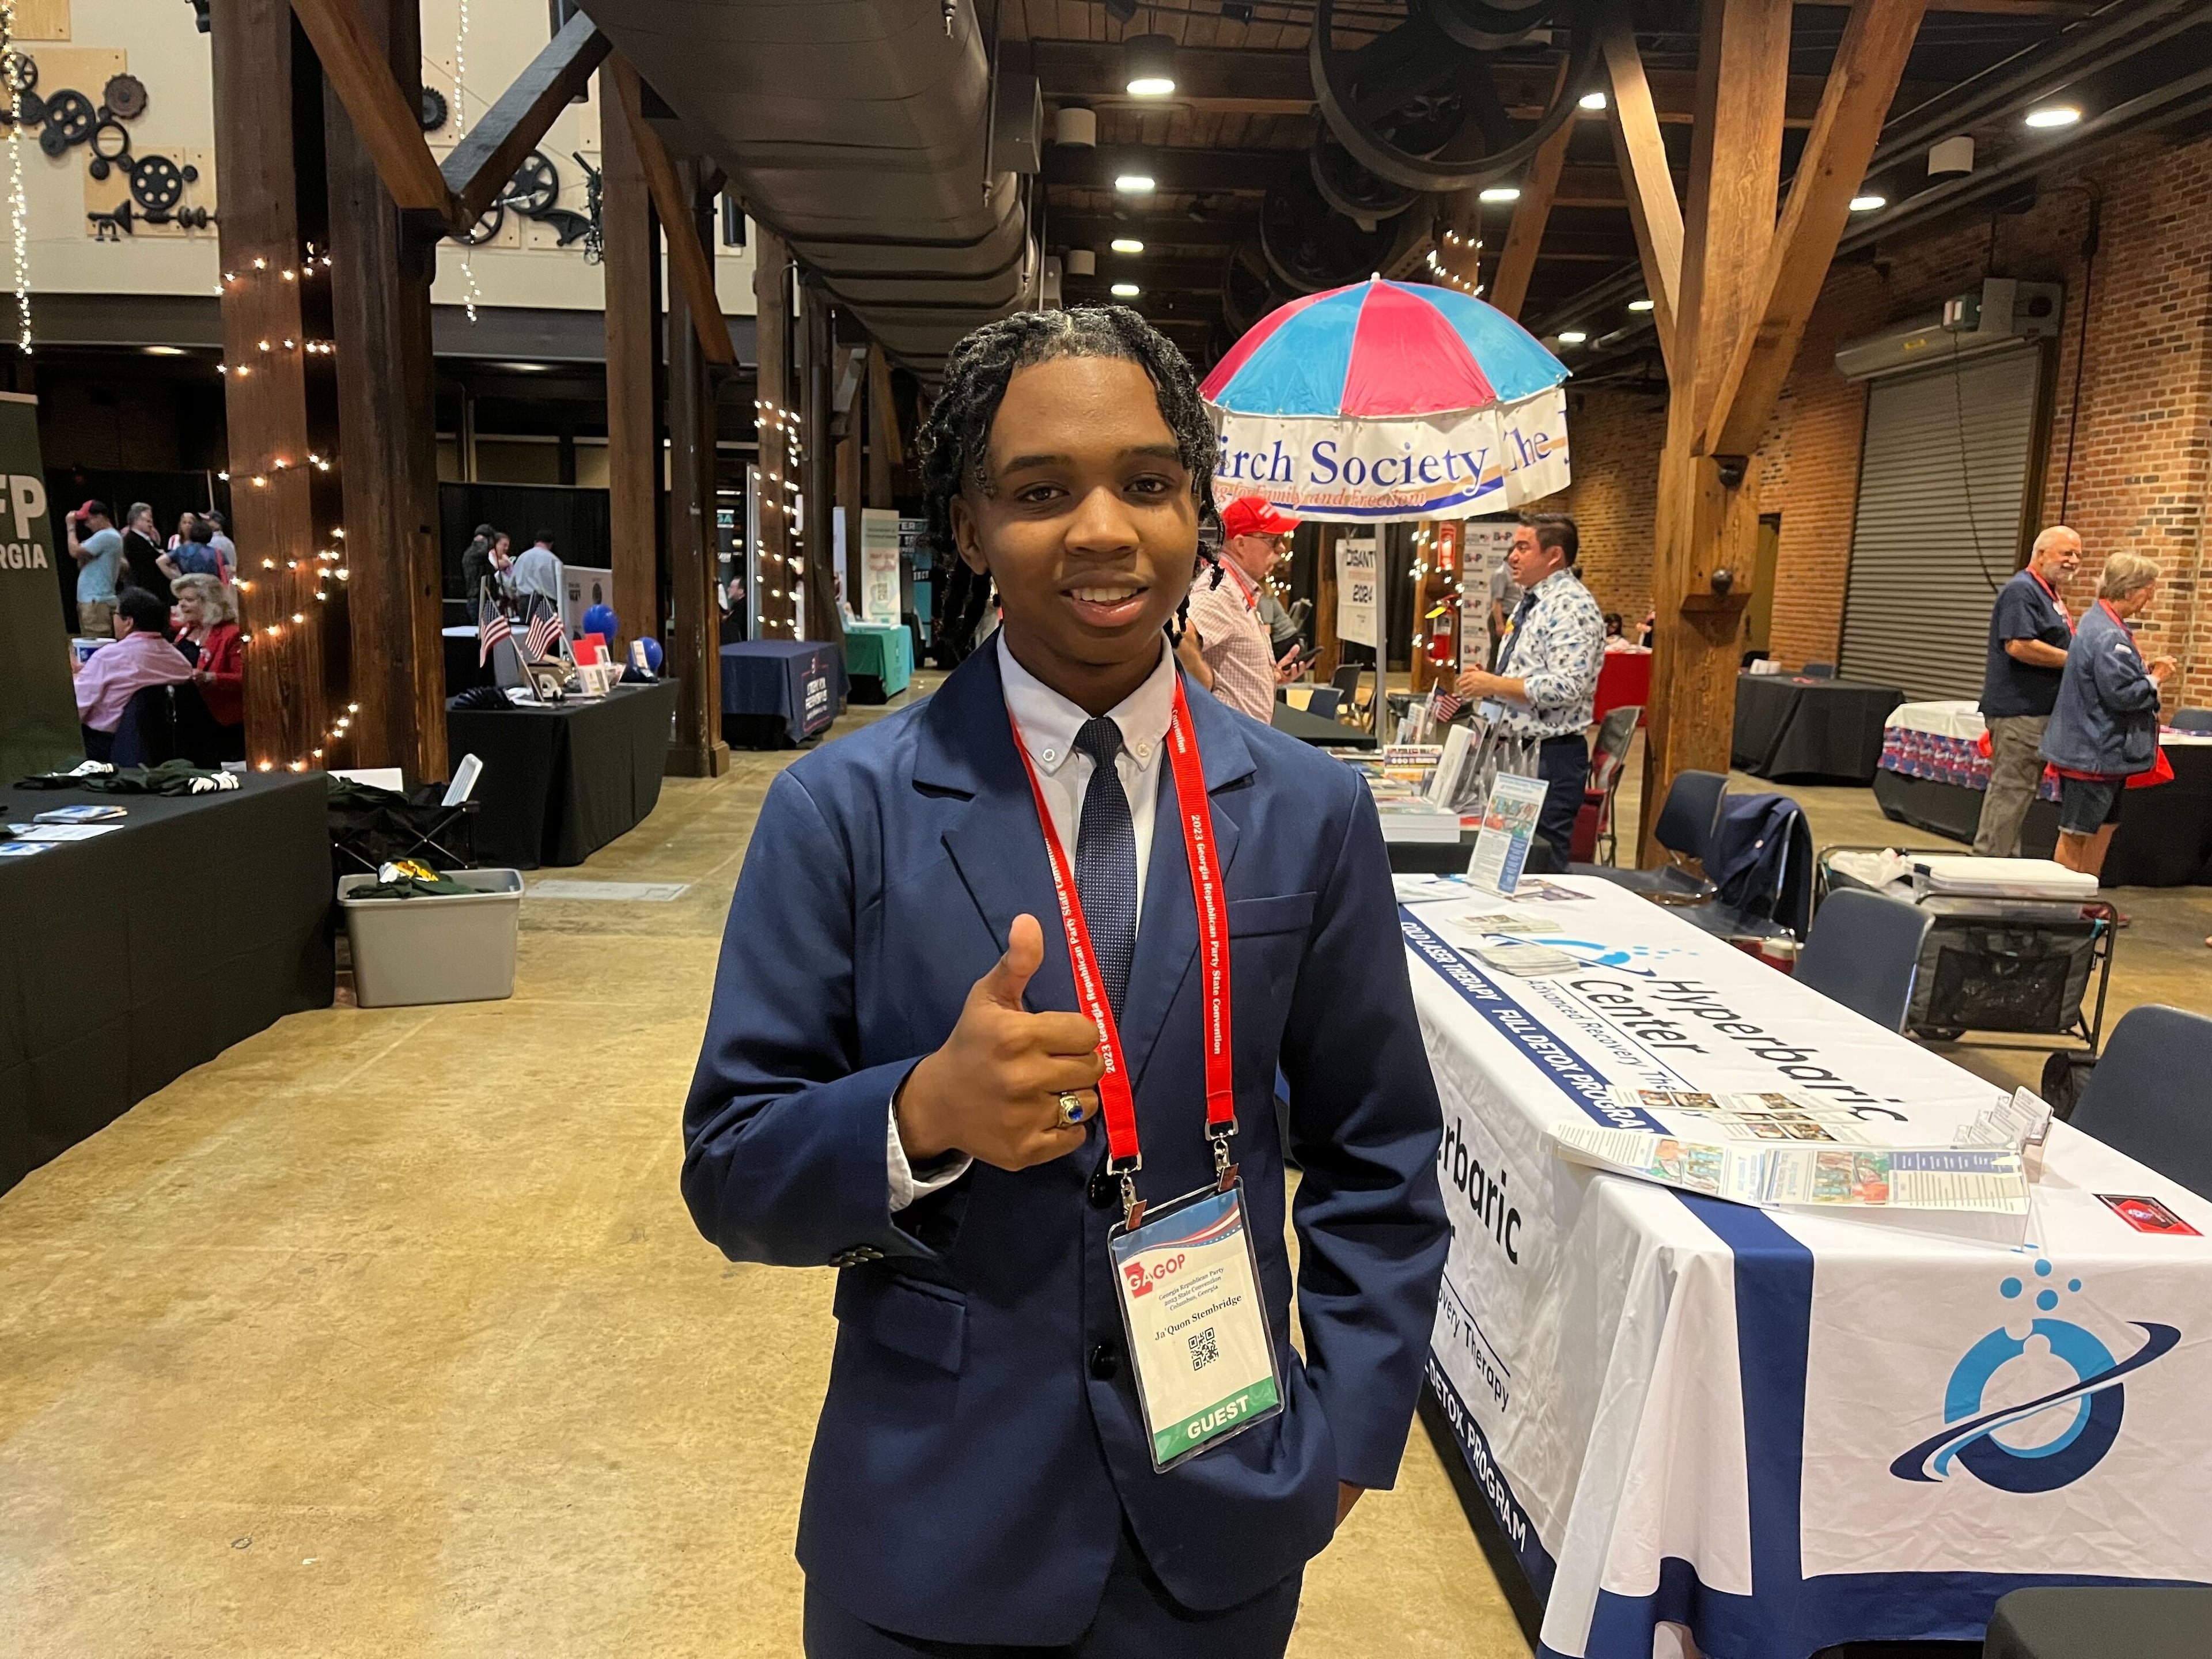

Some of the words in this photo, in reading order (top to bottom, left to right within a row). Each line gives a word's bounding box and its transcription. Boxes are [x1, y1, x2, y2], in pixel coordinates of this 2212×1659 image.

[1310, 441, 1490, 494] Society
[1308, 488, 1347, 506] and
[1349, 490, 1427, 508] Freedom
[1191, 815, 1203, 840] 2023
[1044, 838, 1064, 889] Convention
[1196, 843, 1209, 880] Georgia
[1059, 890, 1071, 916] State
[1203, 882, 1217, 938] Republican
[1066, 918, 1080, 945] Party
[1400, 922, 1431, 940] COLD
[1415, 940, 1458, 963] LASER
[1074, 945, 1097, 1001] Republican
[1210, 941, 1220, 968] Party
[1212, 970, 1221, 995] State
[1442, 963, 1503, 1001] THERAPY
[1090, 1002, 1109, 1043] Georgia
[1213, 998, 1222, 1055] Convention
[1526, 980, 1594, 1020] Advanced
[1576, 1022, 1649, 1067] Recovery
[1570, 980, 1710, 1054] Center
[1101, 1044, 1116, 1074] 2023
[1491, 1009, 1537, 1033] FULL
[1519, 1035, 1585, 1073] DETOX
[1642, 980, 1908, 1122] Hyperbaric
[1437, 1116, 1522, 1265] rbaric
[1158, 1287, 1179, 1300] Georgia
[1180, 1272, 1209, 1292] Republican
[1209, 1267, 1225, 1277] Party
[1164, 1297, 1178, 1306] 2023
[1178, 1289, 1191, 1300] State
[1191, 1276, 1222, 1293] Convention
[1169, 1297, 1198, 1311] Columbus,
[1198, 1285, 1218, 1297] Georgia
[1154, 1319, 1191, 1341] Ja'Quon
[1191, 1295, 1243, 1323] Stembridge
[1464, 1320, 1509, 1413] Therapy
[1187, 1394, 1249, 1440] GUEST
[1429, 1358, 1465, 1438] DETOX
[1467, 1421, 1526, 1553] PROGRAM
